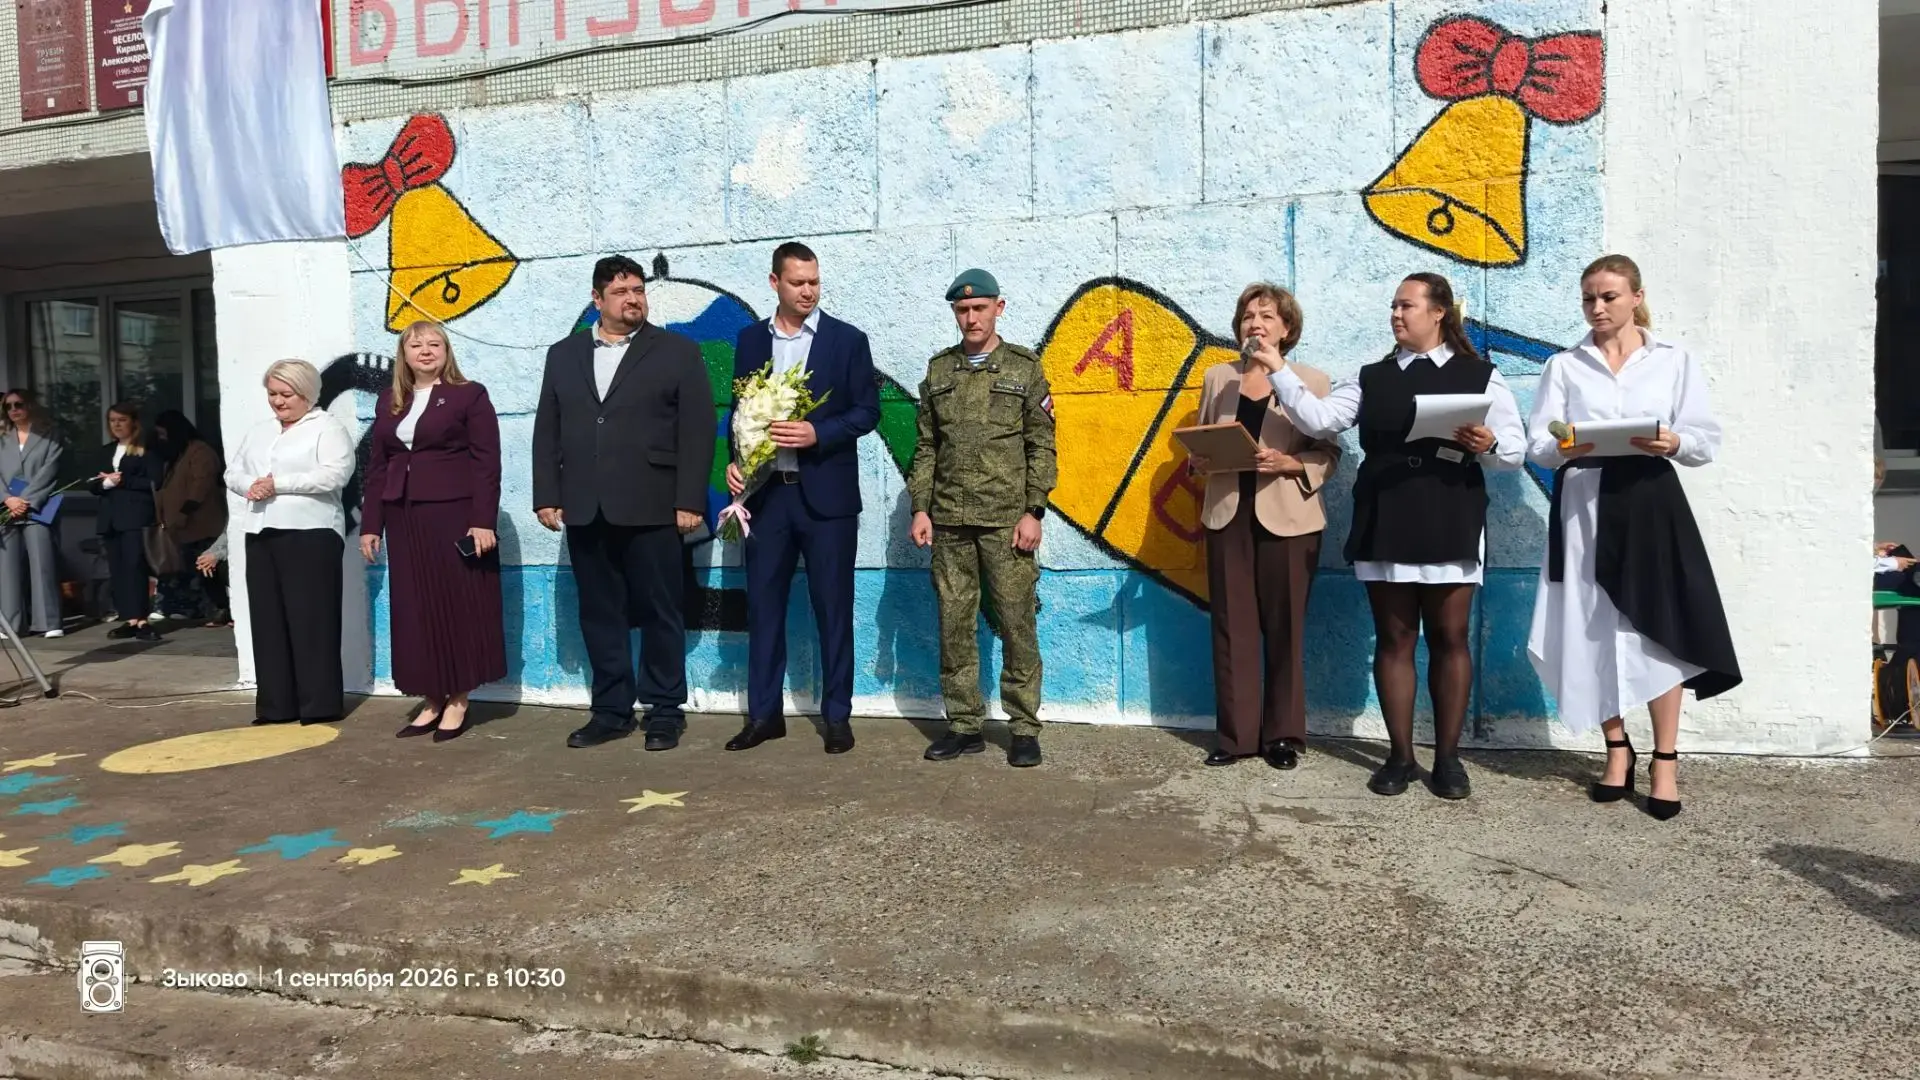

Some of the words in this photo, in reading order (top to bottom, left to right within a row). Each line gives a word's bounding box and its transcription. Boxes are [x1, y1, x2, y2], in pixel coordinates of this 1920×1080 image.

[112, 32, 145, 46] ВЕСЕЛО
[116, 44, 145, 55] Кирилл
[1073, 308, 1134, 392] А
